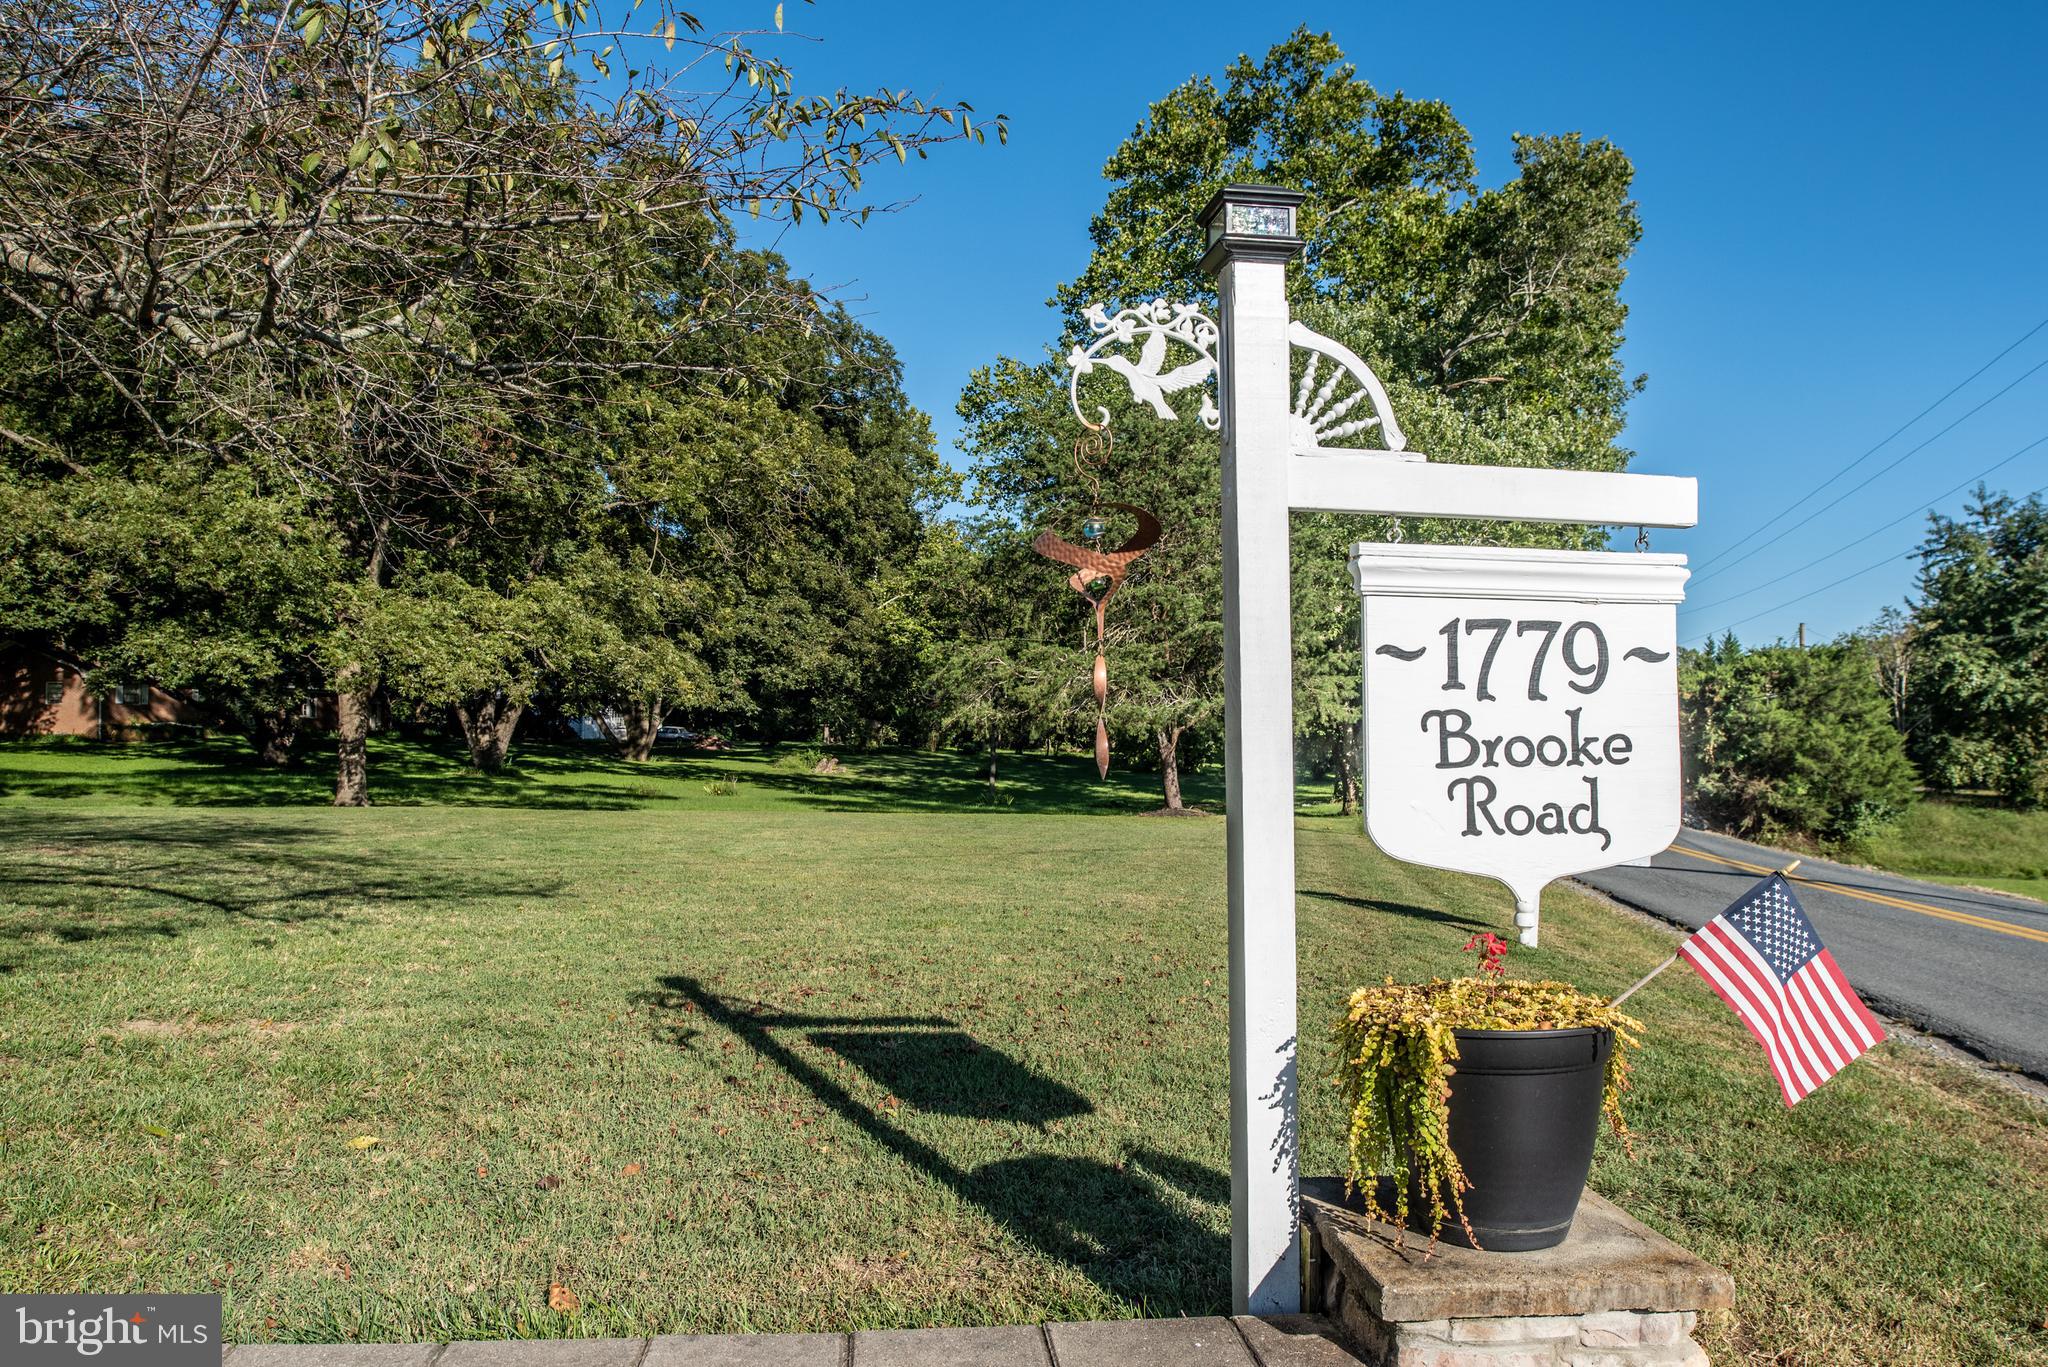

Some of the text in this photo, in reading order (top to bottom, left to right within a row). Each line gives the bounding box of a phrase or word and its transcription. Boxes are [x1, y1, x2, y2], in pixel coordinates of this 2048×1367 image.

[1438, 617, 1609, 702] 1779
[1420, 706, 1633, 769] Brooke
[1447, 775, 1612, 852] Road
